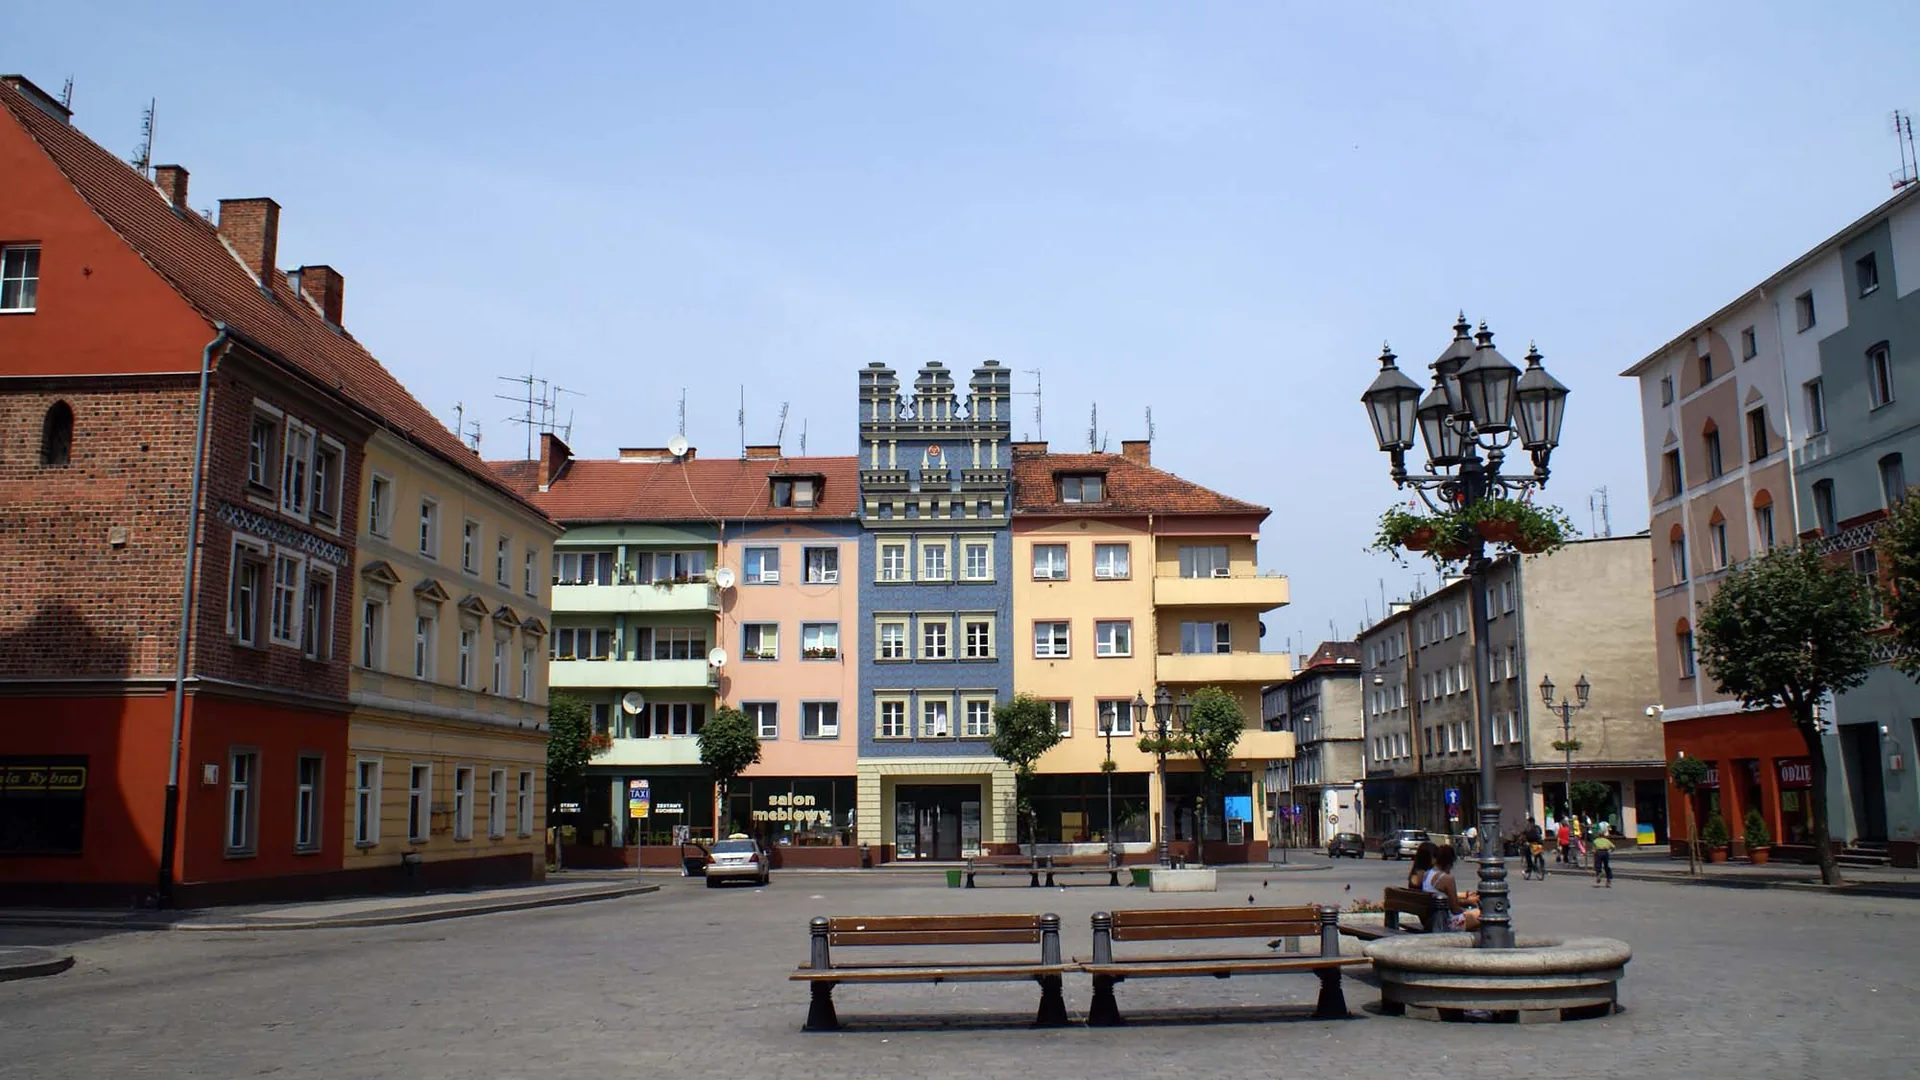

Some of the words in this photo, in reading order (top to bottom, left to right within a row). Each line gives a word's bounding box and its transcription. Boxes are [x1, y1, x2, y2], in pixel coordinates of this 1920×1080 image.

[28, 771, 78, 785] Rybna
[1782, 764, 1811, 782] ODZIE
[631, 790, 649, 798] TAXI
[769, 792, 815, 806] salon
[753, 807, 830, 824] meblowy
